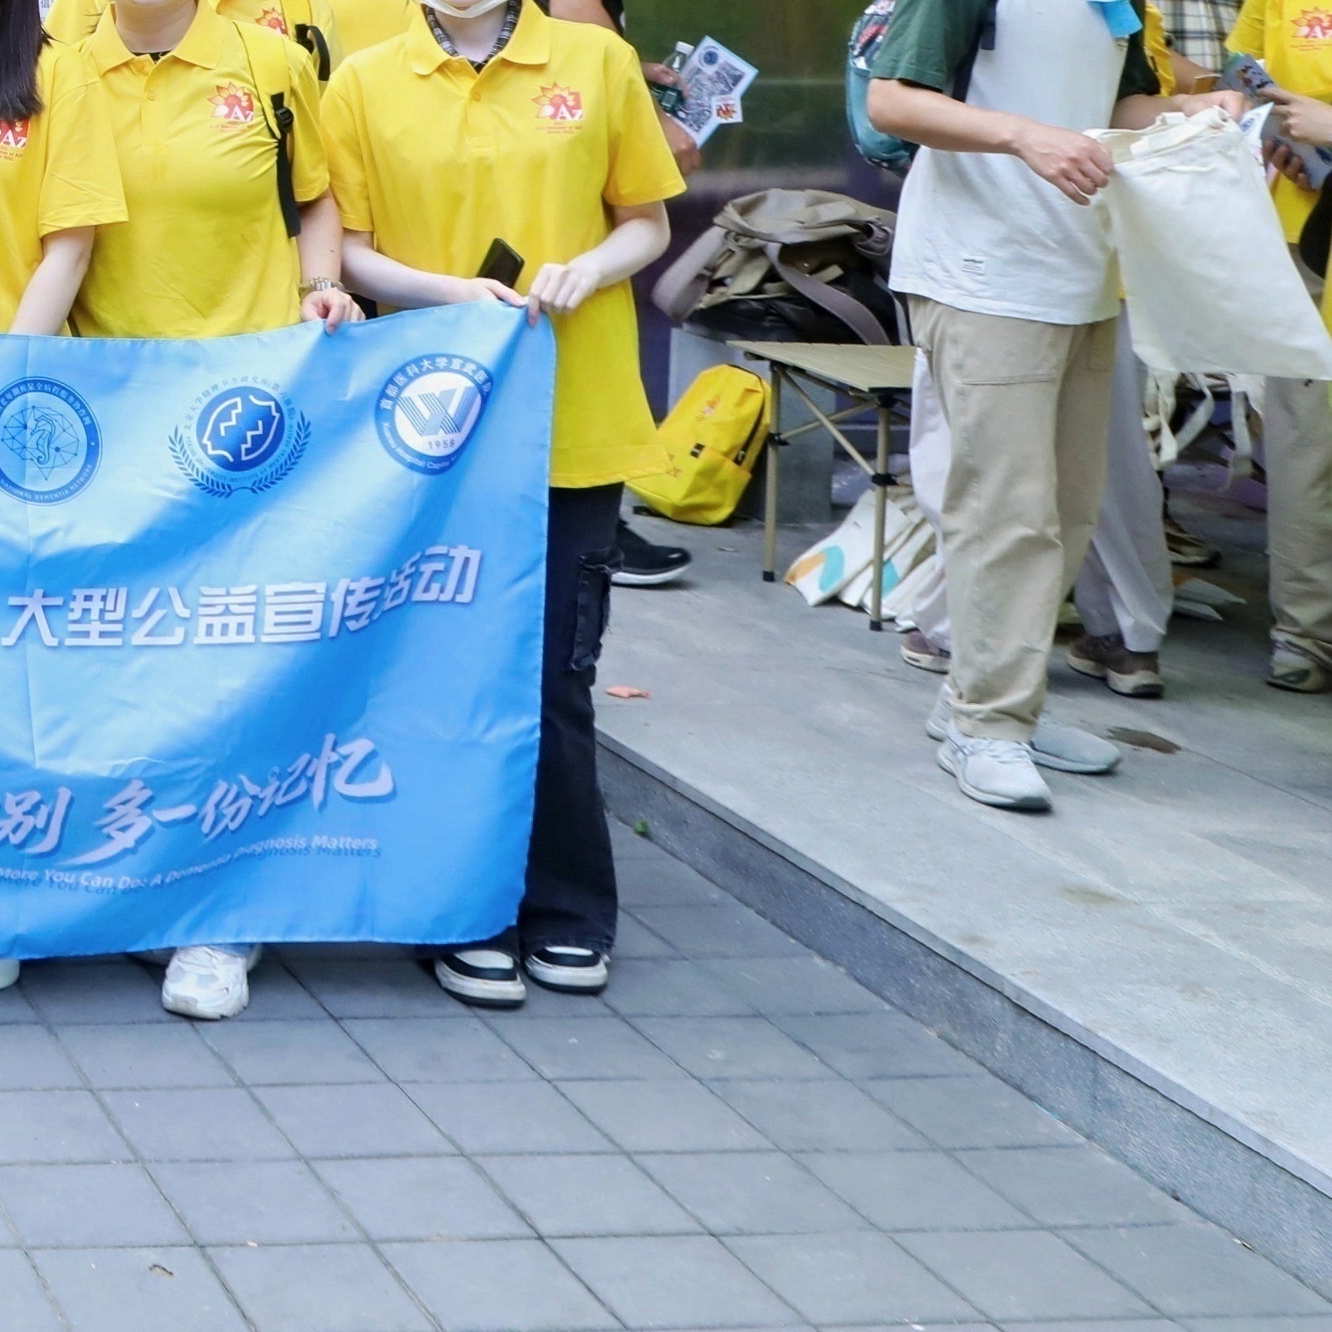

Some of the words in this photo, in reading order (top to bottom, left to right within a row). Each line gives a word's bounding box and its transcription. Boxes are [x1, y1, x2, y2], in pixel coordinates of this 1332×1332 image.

[40, 0, 54, 9] 倡
[428, 439, 456, 450] 1958
[34, 489, 70, 501] DEMENTIA
[1, 543, 483, 648] 大型公益宣传活动
[58, 732, 395, 867] 多一份记忆
[44, 869, 76, 884] You
[80, 872, 114, 888] Can
[150, 874, 162, 886] A
[311, 835, 378, 850] Matters
